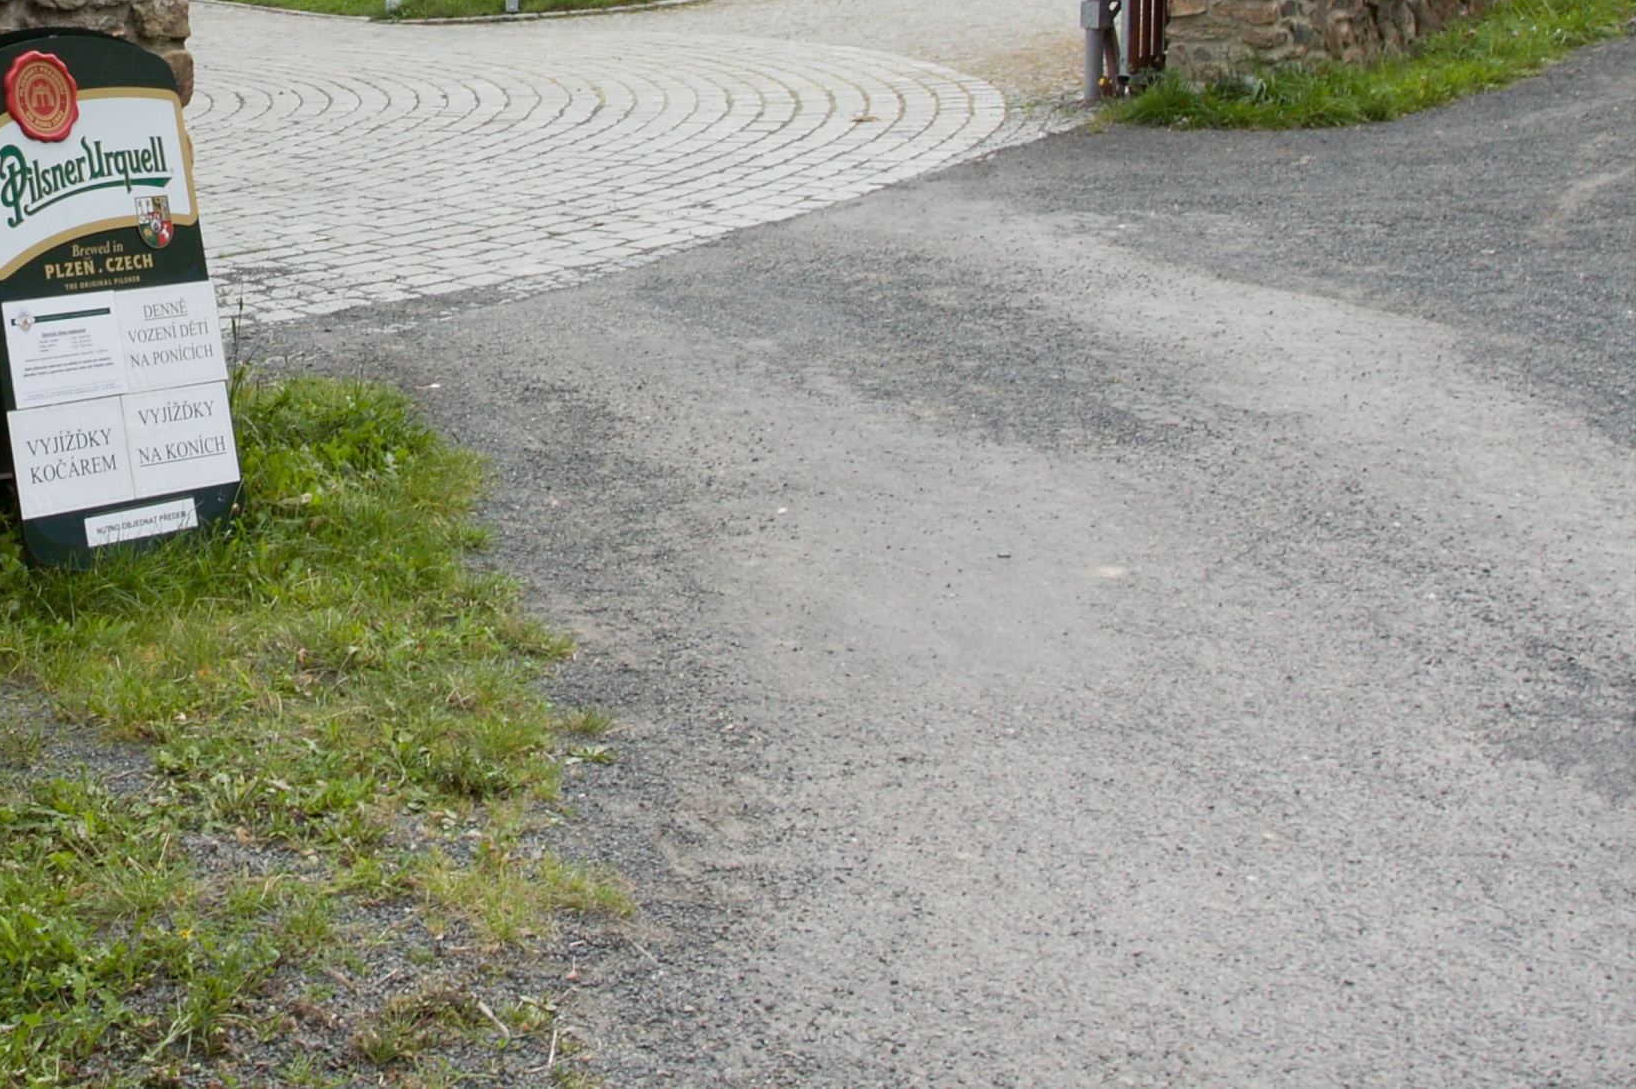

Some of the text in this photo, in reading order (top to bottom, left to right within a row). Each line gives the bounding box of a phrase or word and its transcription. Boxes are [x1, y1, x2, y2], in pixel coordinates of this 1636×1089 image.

[81, 136, 167, 194] Urquell
[72, 240, 123, 257] Brewed in
[44, 253, 154, 279] PLZEŇ CZECH
[65, 275, 141, 291] THE ORIGINAL PILSNER
[143, 298, 187, 319] DENNĚ
[128, 317, 209, 344] VOZENÍ DĚTÍ
[130, 354, 150, 368] NA
[152, 343, 214, 365] PONÍCÍCH
[138, 400, 214, 425] VYJÍŽĎKY
[26, 428, 112, 457] VYJÍŽĎKY
[138, 434, 226, 464] NA KONÍCH
[30, 454, 117, 484] KOČÁREM
[96, 524, 121, 535] NUTNO
[121, 516, 158, 531] OBJEDNAT
